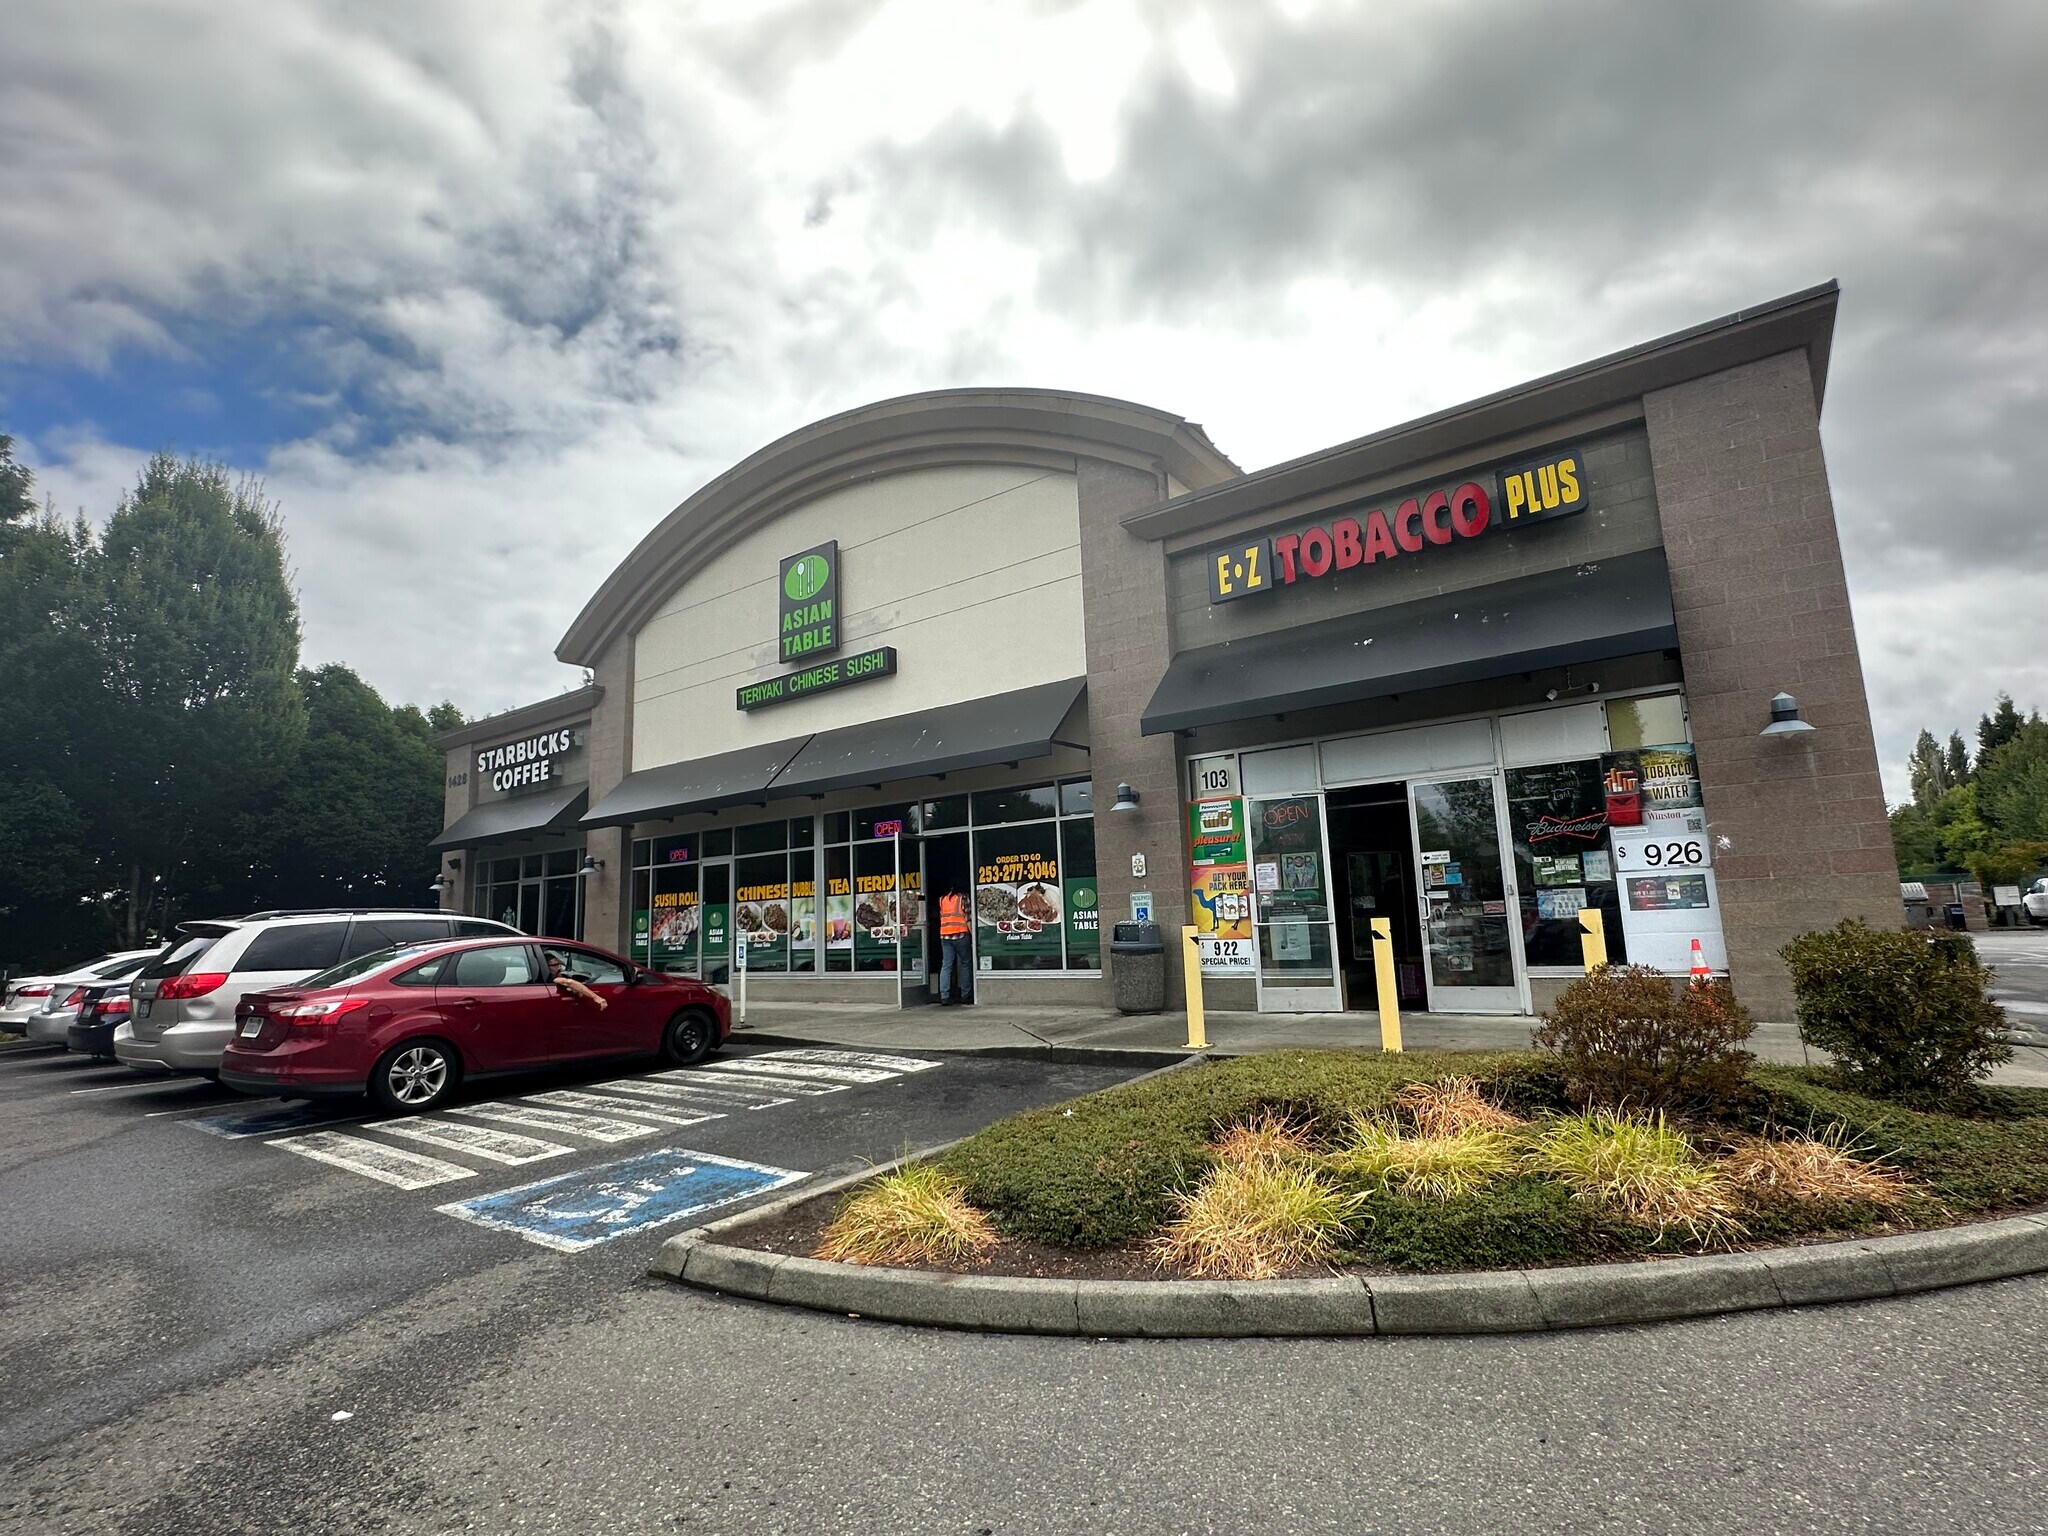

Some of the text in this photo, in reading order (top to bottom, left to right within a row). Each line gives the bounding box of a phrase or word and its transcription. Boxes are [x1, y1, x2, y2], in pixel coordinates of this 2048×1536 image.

[1276, 481, 1491, 584] TOBACCO
[1504, 458, 1581, 519] PLUS
[783, 600, 832, 632] ASIAN
[783, 625, 832, 656] TABLE
[740, 651, 884, 705] TERIYAKI CHINESE SUSHI
[478, 729, 570, 773] STARBUCKS
[493, 760, 549, 792] COFFEE
[1644, 762, 1691, 780] TOBACCO
[448, 773, 468, 789] 1428
[1201, 769, 1228, 790] 103
[1652, 784, 1689, 800] WATER
[1264, 805, 1309, 825] OPEN
[1647, 812, 1682, 821] Winston
[875, 822, 901, 836] OPEN
[1526, 821, 1607, 836] Budweiser
[1193, 832, 1241, 848] pleasure!
[671, 850, 688, 861] OPEN
[996, 853, 1041, 864] ORDER TO GO
[1618, 841, 1703, 867] $ 9.26
[978, 860, 1057, 883] 253-277-3046
[1212, 871, 1247, 882] GET YOUR
[737, 884, 788, 901] CHINESE
[793, 878, 850, 897] BUBBLE TEA
[1209, 879, 1248, 891] PACK HERE
[654, 891, 698, 907] SUSHI ROLL
[1073, 911, 1098, 920] ASIAN
[1073, 921, 1098, 930] TABLE
[1201, 957, 1251, 966] SPECIAL PRICE!
